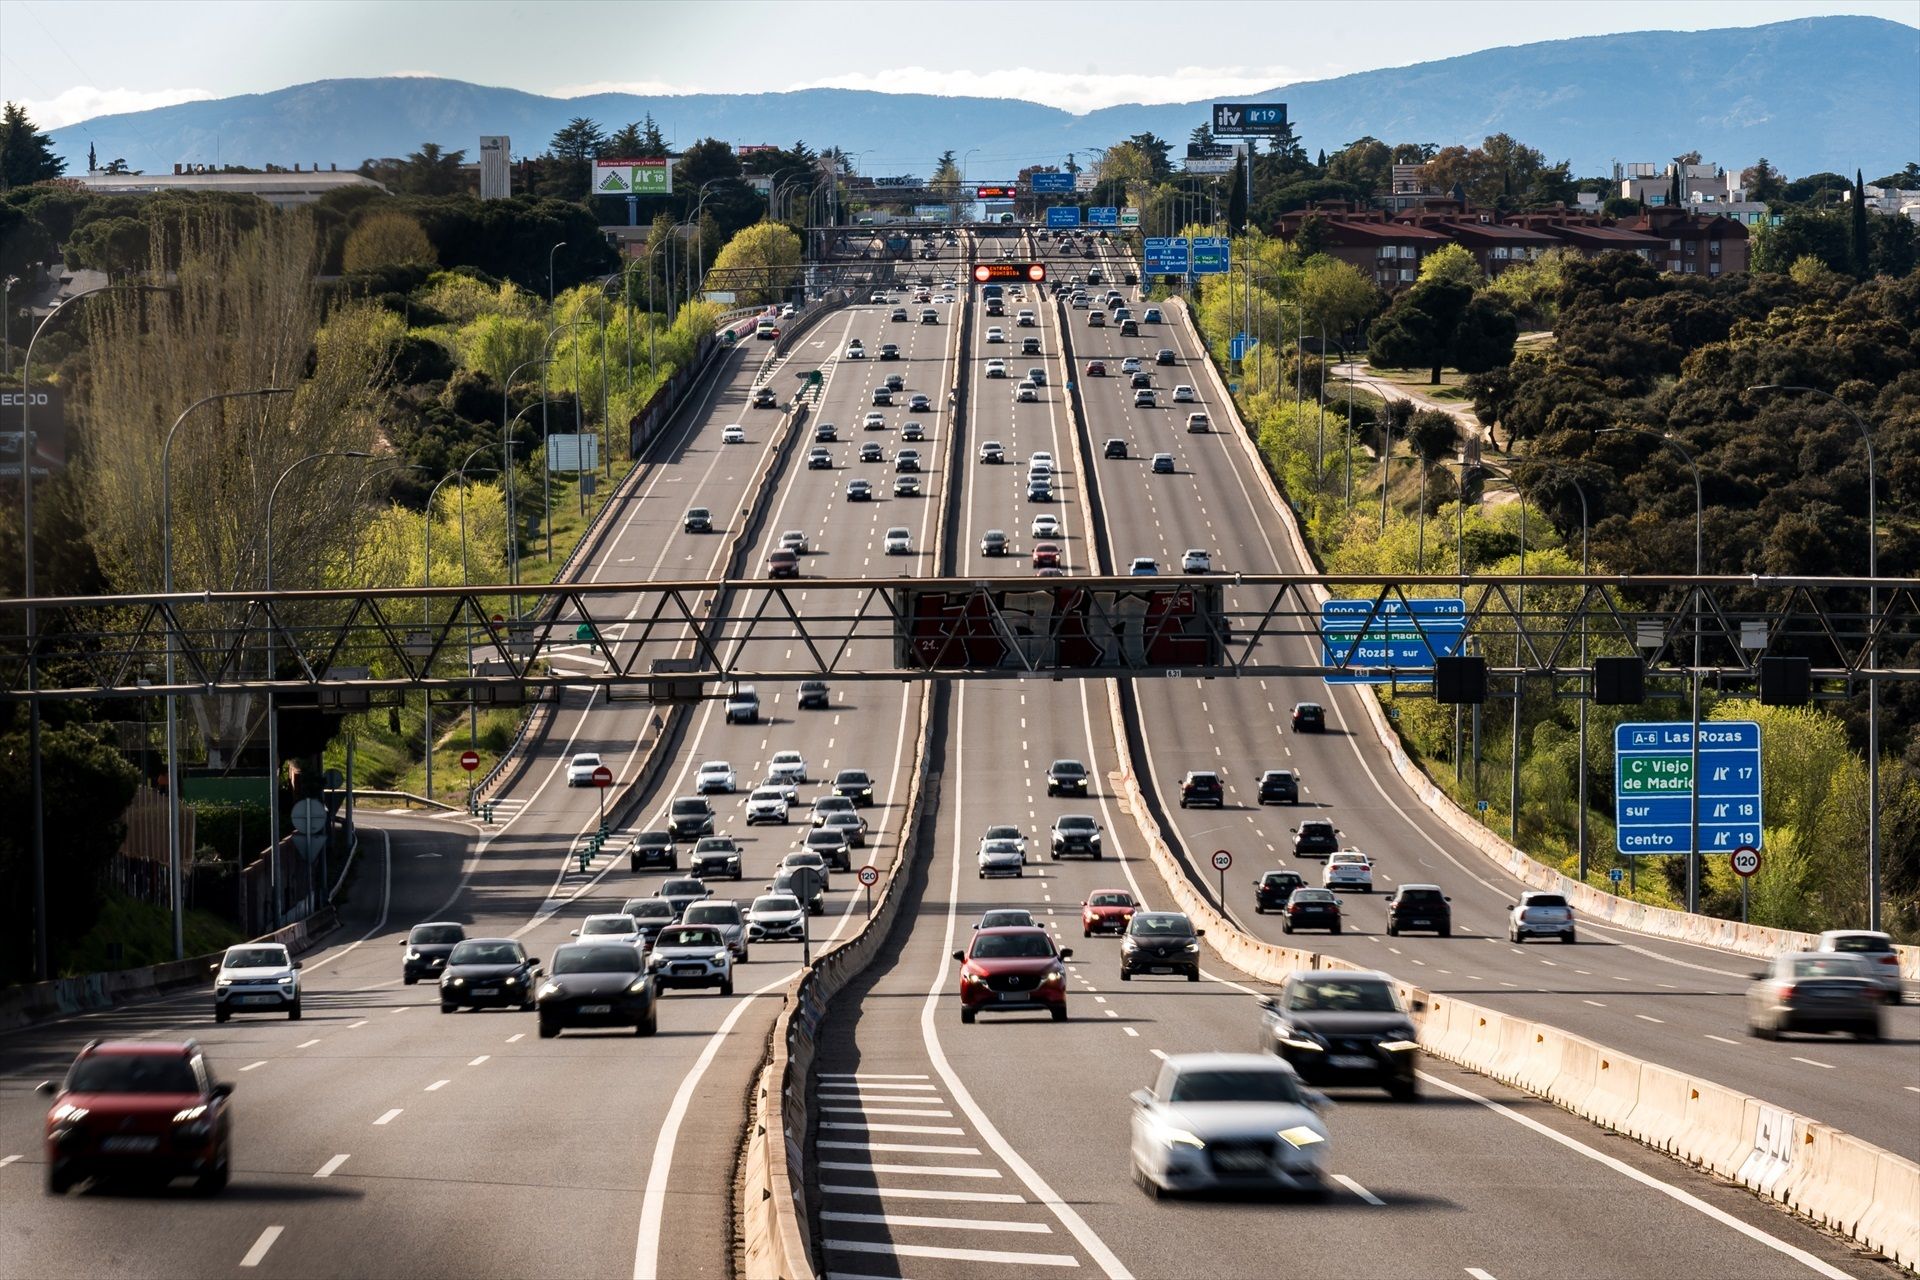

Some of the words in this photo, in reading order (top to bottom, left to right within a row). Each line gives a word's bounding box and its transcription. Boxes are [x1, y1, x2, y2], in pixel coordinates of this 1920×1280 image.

[1218, 106, 1241, 126] itv
[1262, 110, 1276, 121] 19
[598, 173, 613, 190] LEROY
[611, 170, 630, 190] MERLIN
[654, 174, 664, 182] 19
[1358, 647, 1395, 658] Rozas
[1402, 649, 1419, 658] sur
[1634, 732, 1656, 744] A-6
[1664, 731, 1690, 743] Las
[1698, 730, 1742, 743] Rozas
[1652, 760, 1689, 775] Viejo
[1738, 767, 1753, 780] 17
[1623, 777, 1642, 789] de
[1626, 806, 1650, 817] sur
[1738, 804, 1753, 816] 18
[1626, 833, 1673, 846] centro
[1738, 832, 1754, 844] 19
[1736, 856, 1756, 866] 120
[861, 872, 875, 880] 120
